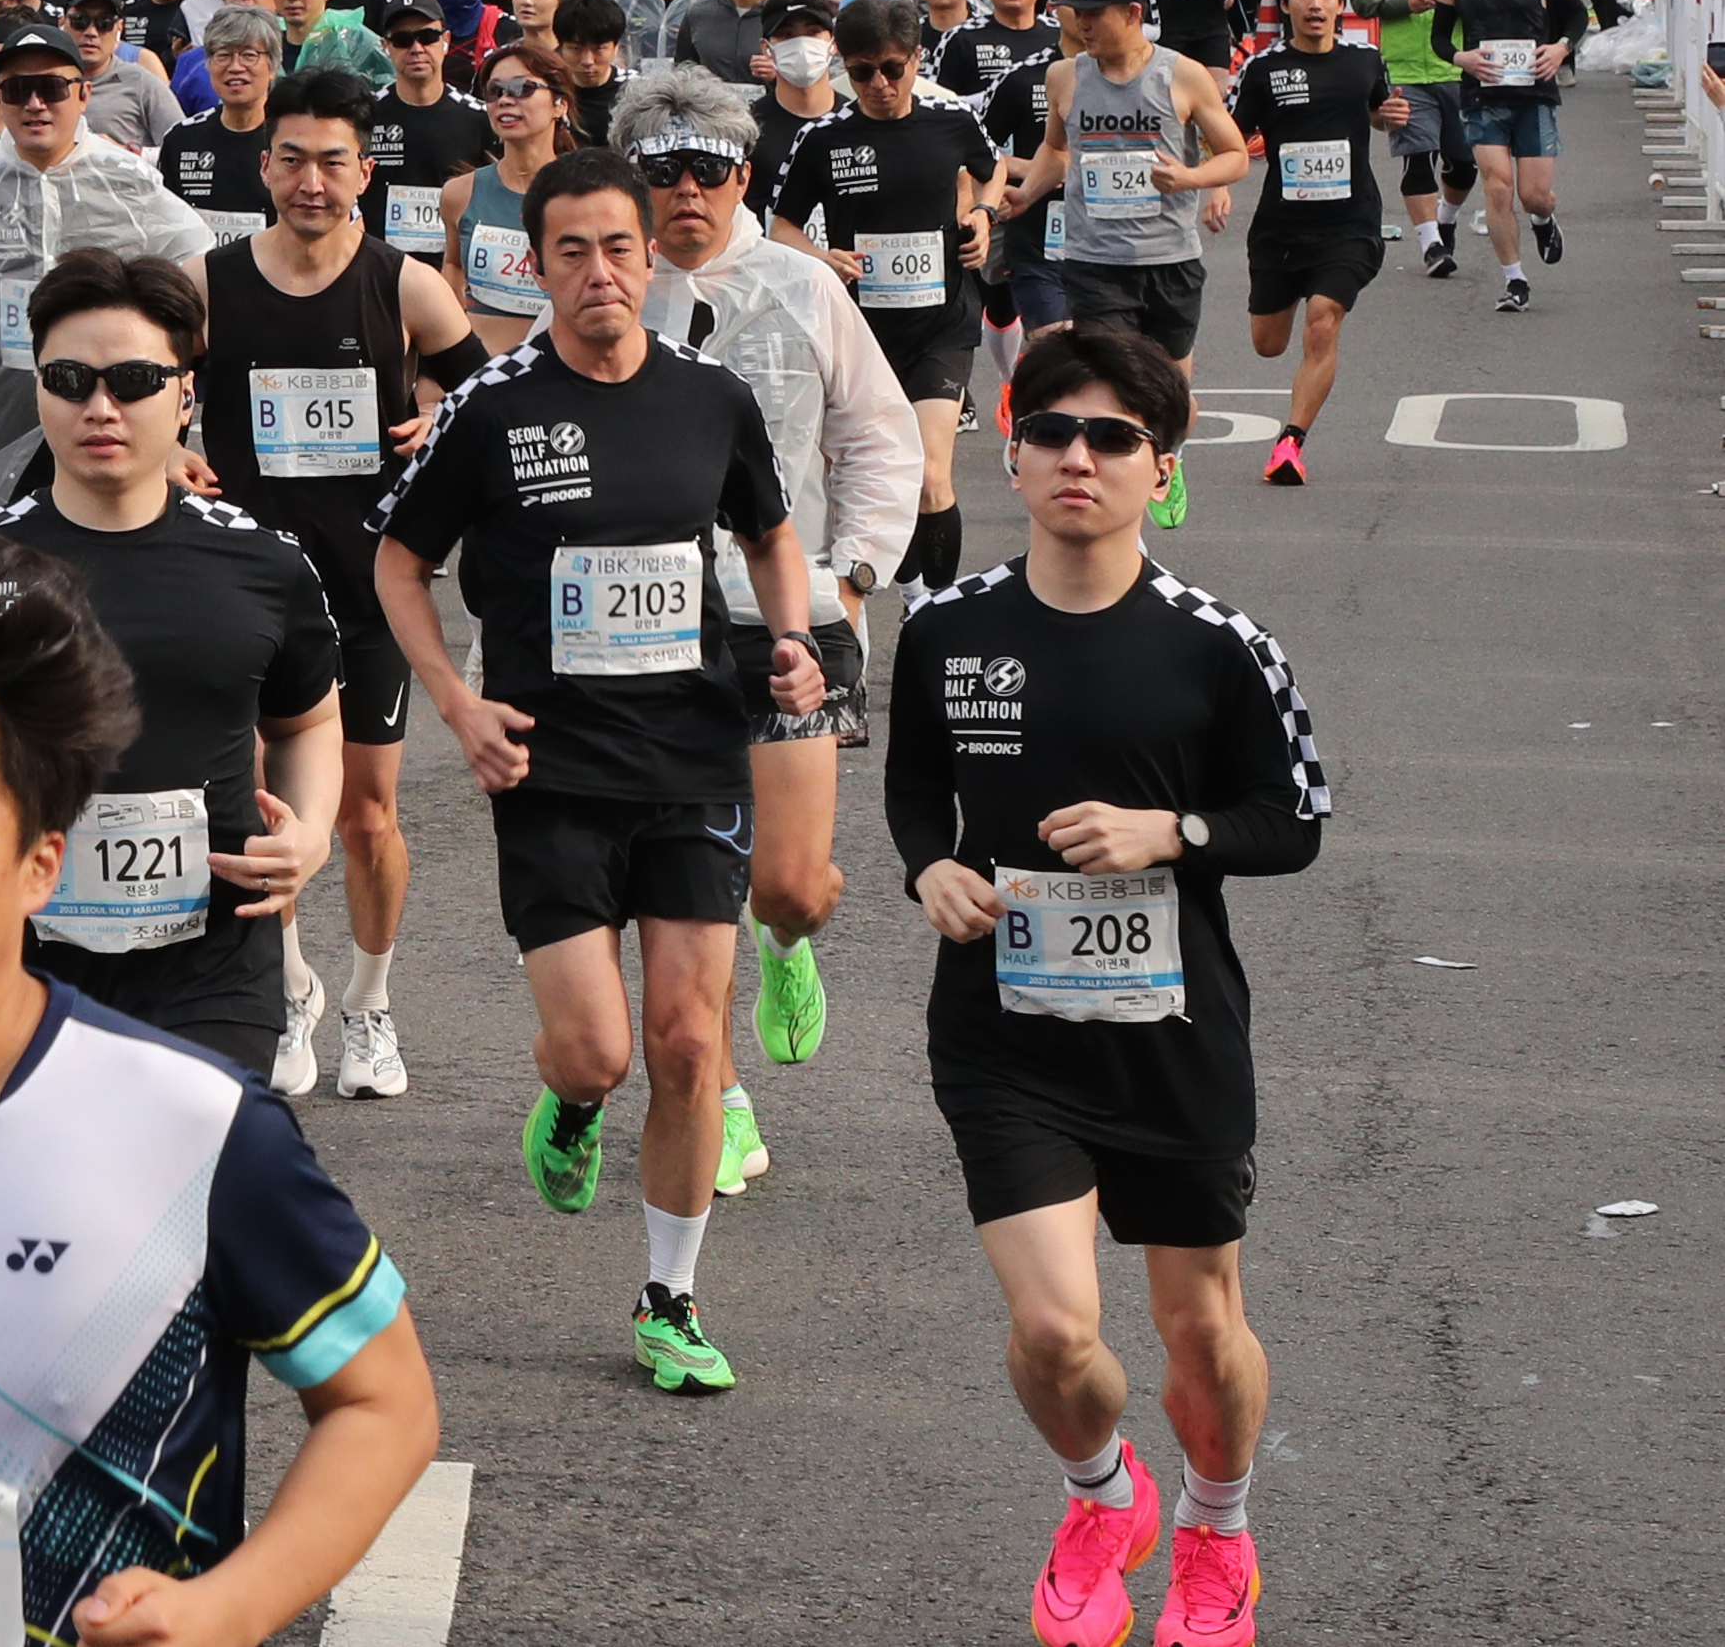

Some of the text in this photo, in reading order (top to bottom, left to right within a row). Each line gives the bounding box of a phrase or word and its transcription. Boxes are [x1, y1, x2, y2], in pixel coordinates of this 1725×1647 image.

[1080, 109, 1162, 133] brooks
[831, 157, 851, 169] HALF
[832, 165, 878, 181] MARATHON
[1284, 157, 1345, 175] C 5449
[179, 171, 213, 181] MARATHON
[1086, 171, 1147, 190] B 524
[391, 204, 401, 221] B
[474, 247, 531, 278] B 24
[892, 253, 932, 275] 608
[6, 306, 21, 328] B
[288, 375, 369, 391] KB금융그룹
[260, 399, 355, 429] B 615
[507, 425, 549, 445] SEOUL
[510, 443, 547, 464] HALF
[513, 455, 590, 481] MARATHON
[542, 486, 593, 504] BROOKS
[597, 554, 688, 574] IBK기업은행
[562, 580, 687, 618] B 2103
[557, 619, 588, 629] HALF
[945, 656, 984, 676] SEOUL
[944, 678, 977, 698] HALF
[945, 701, 1022, 721] MARATHON
[967, 742, 1023, 755] BROOKS
[94, 835, 183, 882] 1221
[124, 881, 160, 898] 전은성
[1047, 875, 1166, 901] KB금융그룹
[80, 903, 105, 916] SEOUL
[109, 903, 129, 915] HALF
[132, 902, 180, 915] MARATHON
[131, 916, 201, 942] 조선일보
[1007, 910, 1152, 957] B 208
[1003, 953, 1039, 966] HALF
[1095, 957, 1131, 971] 이권재
